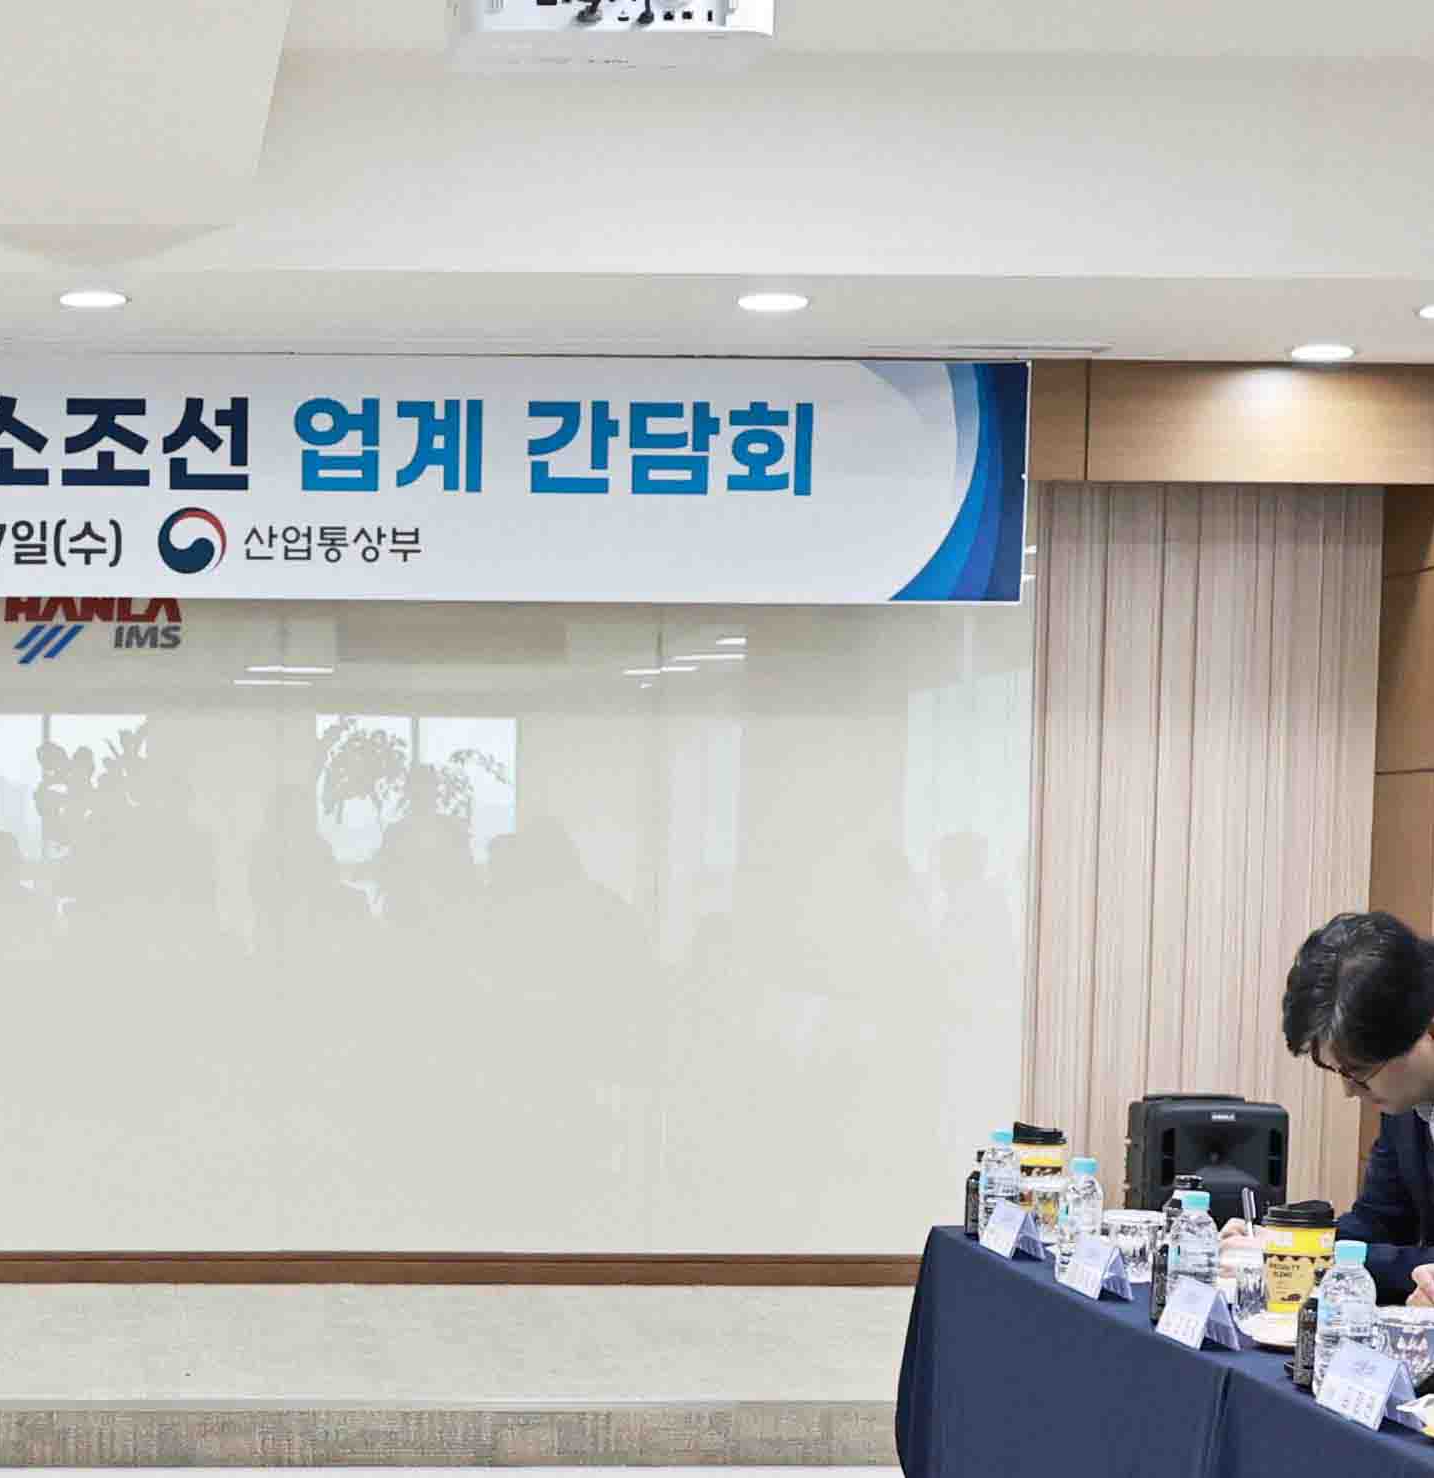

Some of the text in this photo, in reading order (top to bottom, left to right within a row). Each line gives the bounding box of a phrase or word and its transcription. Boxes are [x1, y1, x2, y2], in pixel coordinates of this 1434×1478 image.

[293, 396, 484, 495] 업계
[526, 399, 815, 497] 간담회
[243, 525, 423, 564] 산업통상부
[4, 596, 182, 622] HANLA
[114, 625, 182, 649] IMS
